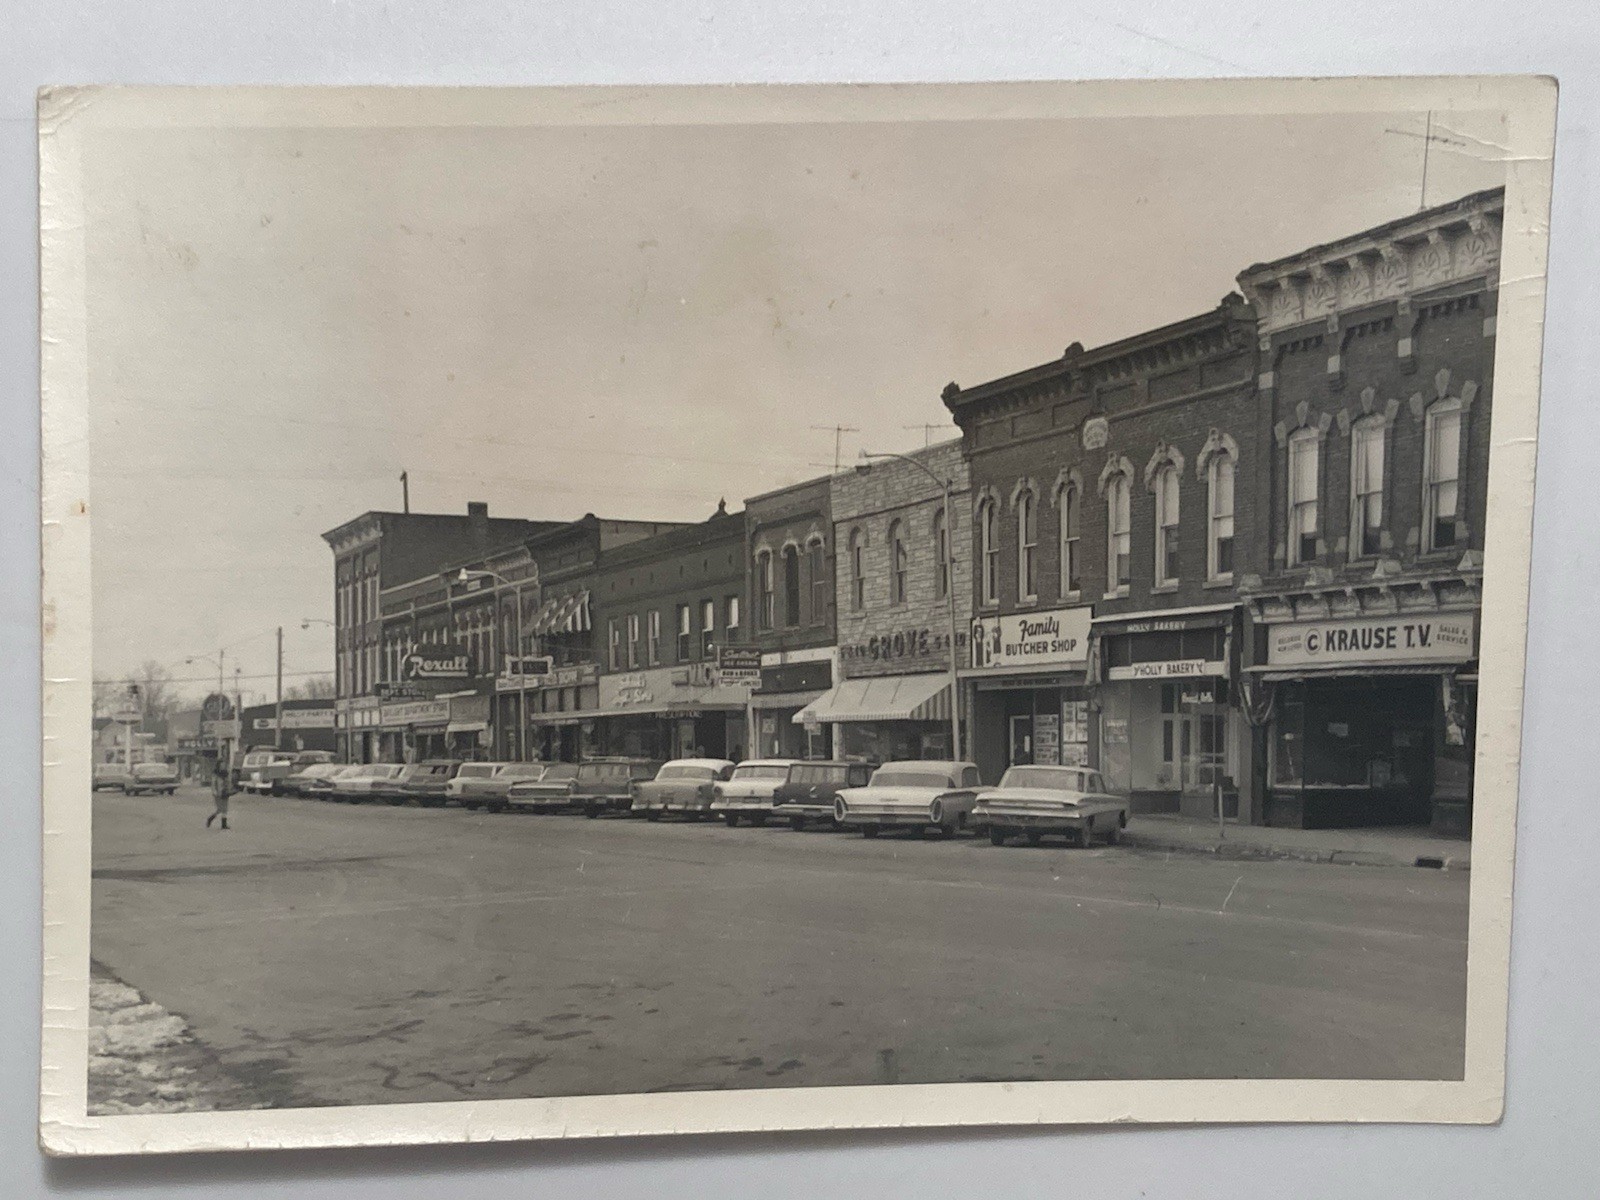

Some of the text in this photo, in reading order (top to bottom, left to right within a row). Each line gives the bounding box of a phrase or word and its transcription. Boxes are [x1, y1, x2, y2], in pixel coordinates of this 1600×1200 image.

[1019, 616, 1060, 641] Family
[1126, 621, 1186, 633] HOLLY BAKERY
[1326, 627, 1398, 651] KRAUSE
[1404, 624, 1431, 649] T.V.
[1437, 633, 1468, 645] SERVICE
[1006, 639, 1077, 656] BUTCHER SHOP
[410, 656, 468, 677] Rexall
[1140, 663, 1195, 676] HOLLY BAKERY
